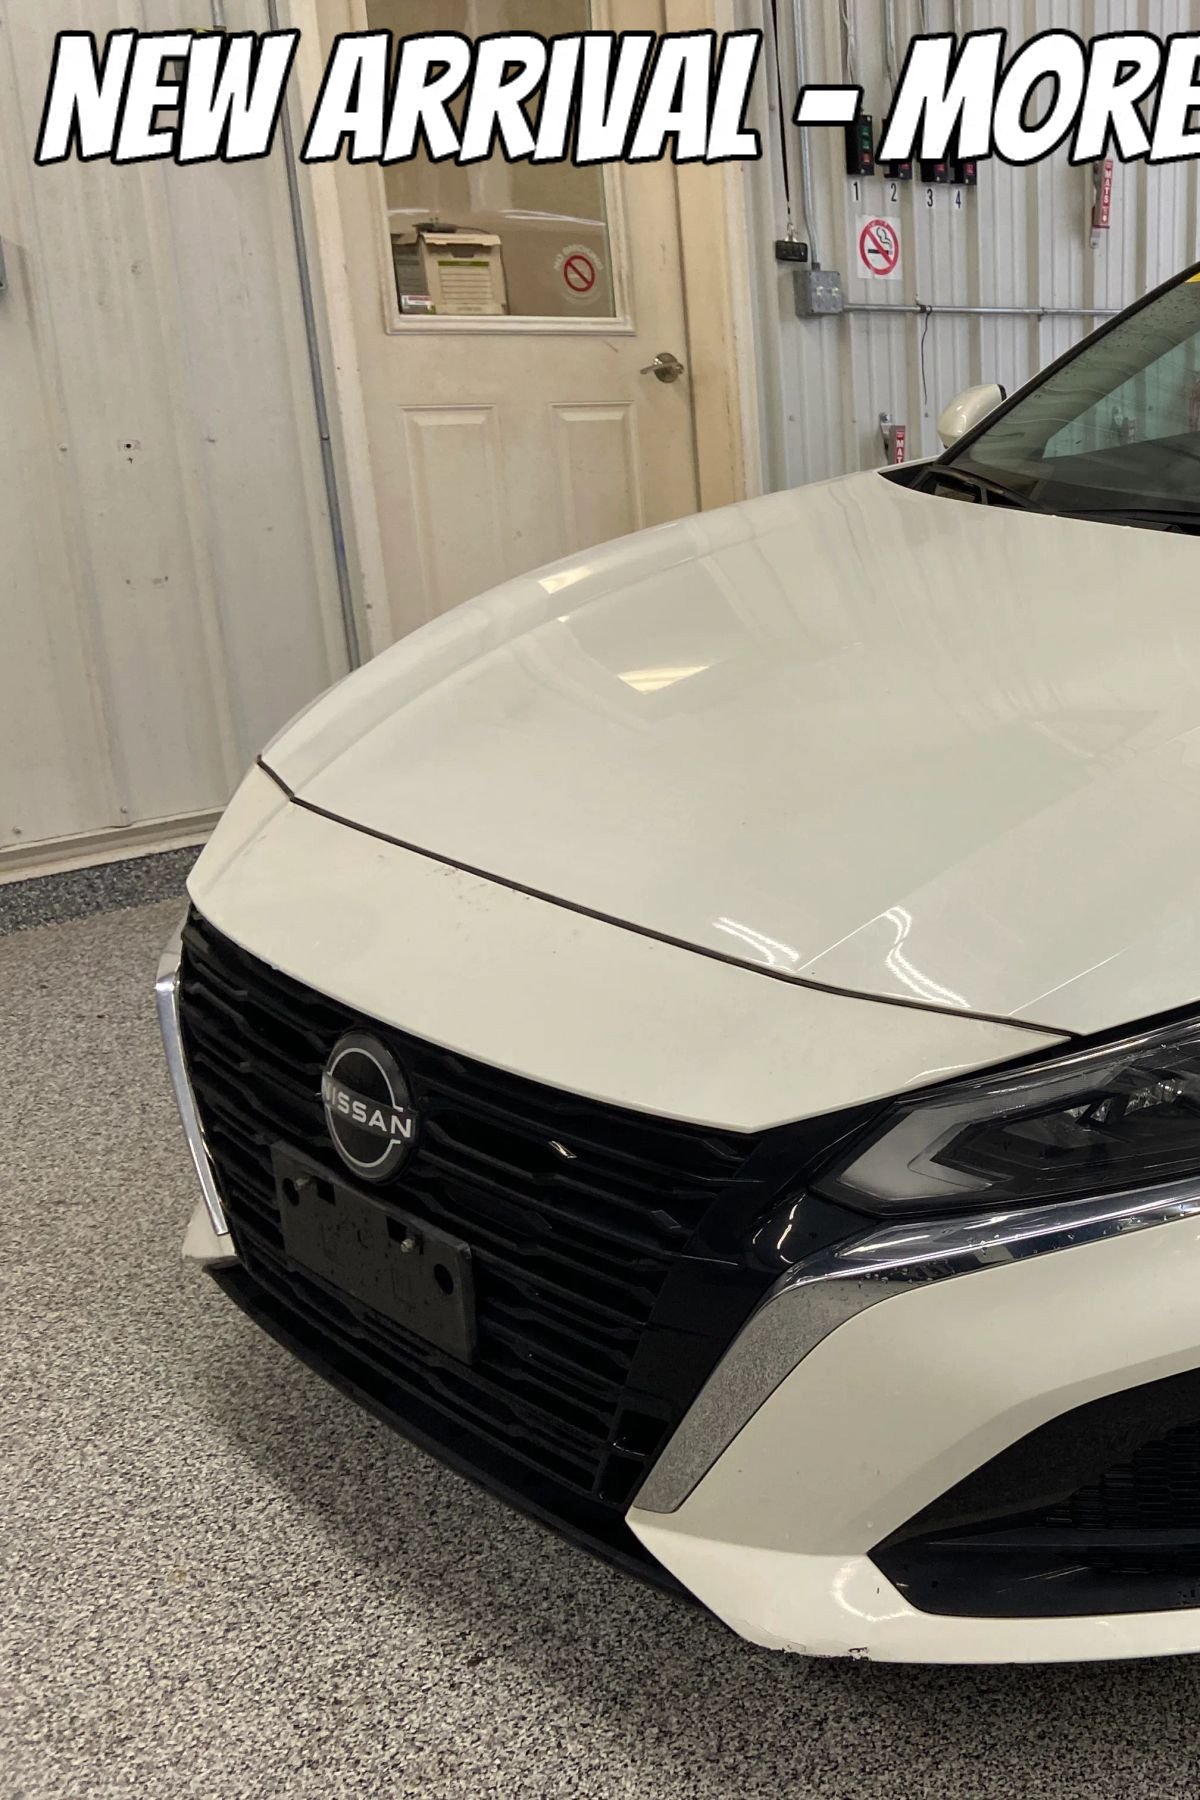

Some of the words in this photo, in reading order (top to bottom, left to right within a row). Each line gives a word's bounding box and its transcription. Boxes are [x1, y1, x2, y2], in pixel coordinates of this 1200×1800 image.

[853, 181, 859, 201] 1
[890, 182, 897, 202] 2
[1103, 169, 1112, 203] MATS
[926, 188, 934, 207] 3
[955, 190, 962, 208] 4
[323, 1081, 412, 1138] NISSAN
